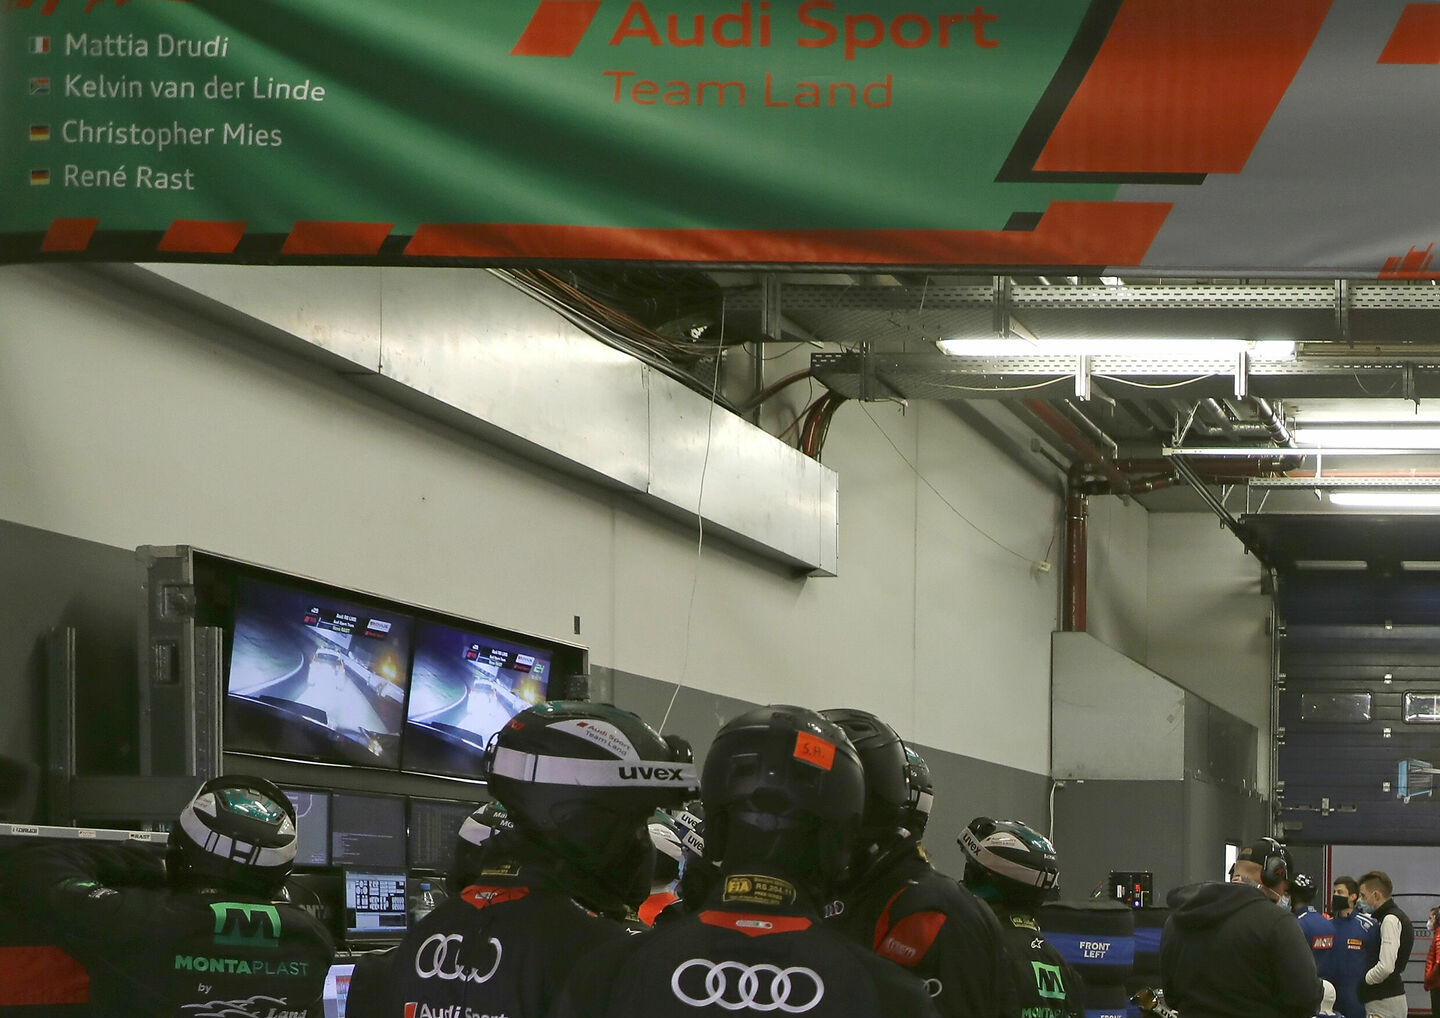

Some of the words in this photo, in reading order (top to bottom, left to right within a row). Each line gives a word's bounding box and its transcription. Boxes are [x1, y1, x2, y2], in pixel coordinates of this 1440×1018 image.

[608, 1, 771, 46] Audi
[796, 2, 999, 60] Sport
[66, 33, 148, 56] Mattia
[157, 35, 228, 58] Drudi
[66, 75, 142, 99] Kelvin
[150, 81, 197, 100] van
[204, 77, 246, 101] der
[253, 78, 325, 102] Linde
[602, 71, 745, 106] Team
[764, 73, 893, 108] Land
[63, 120, 214, 151] Christopher
[223, 123, 282, 148] Mies
[65, 164, 126, 188] René
[137, 166, 194, 191] Rast
[619, 766, 684, 781] uvex
[681, 814, 697, 827] uve
[687, 836, 703, 850] uve
[962, 833, 981, 856] uvex
[1079, 941, 1111, 951] FRONT
[1084, 950, 1106, 959] LEFT
[174, 955, 309, 976] MONTAPLAST
[198, 983, 212, 993] by
